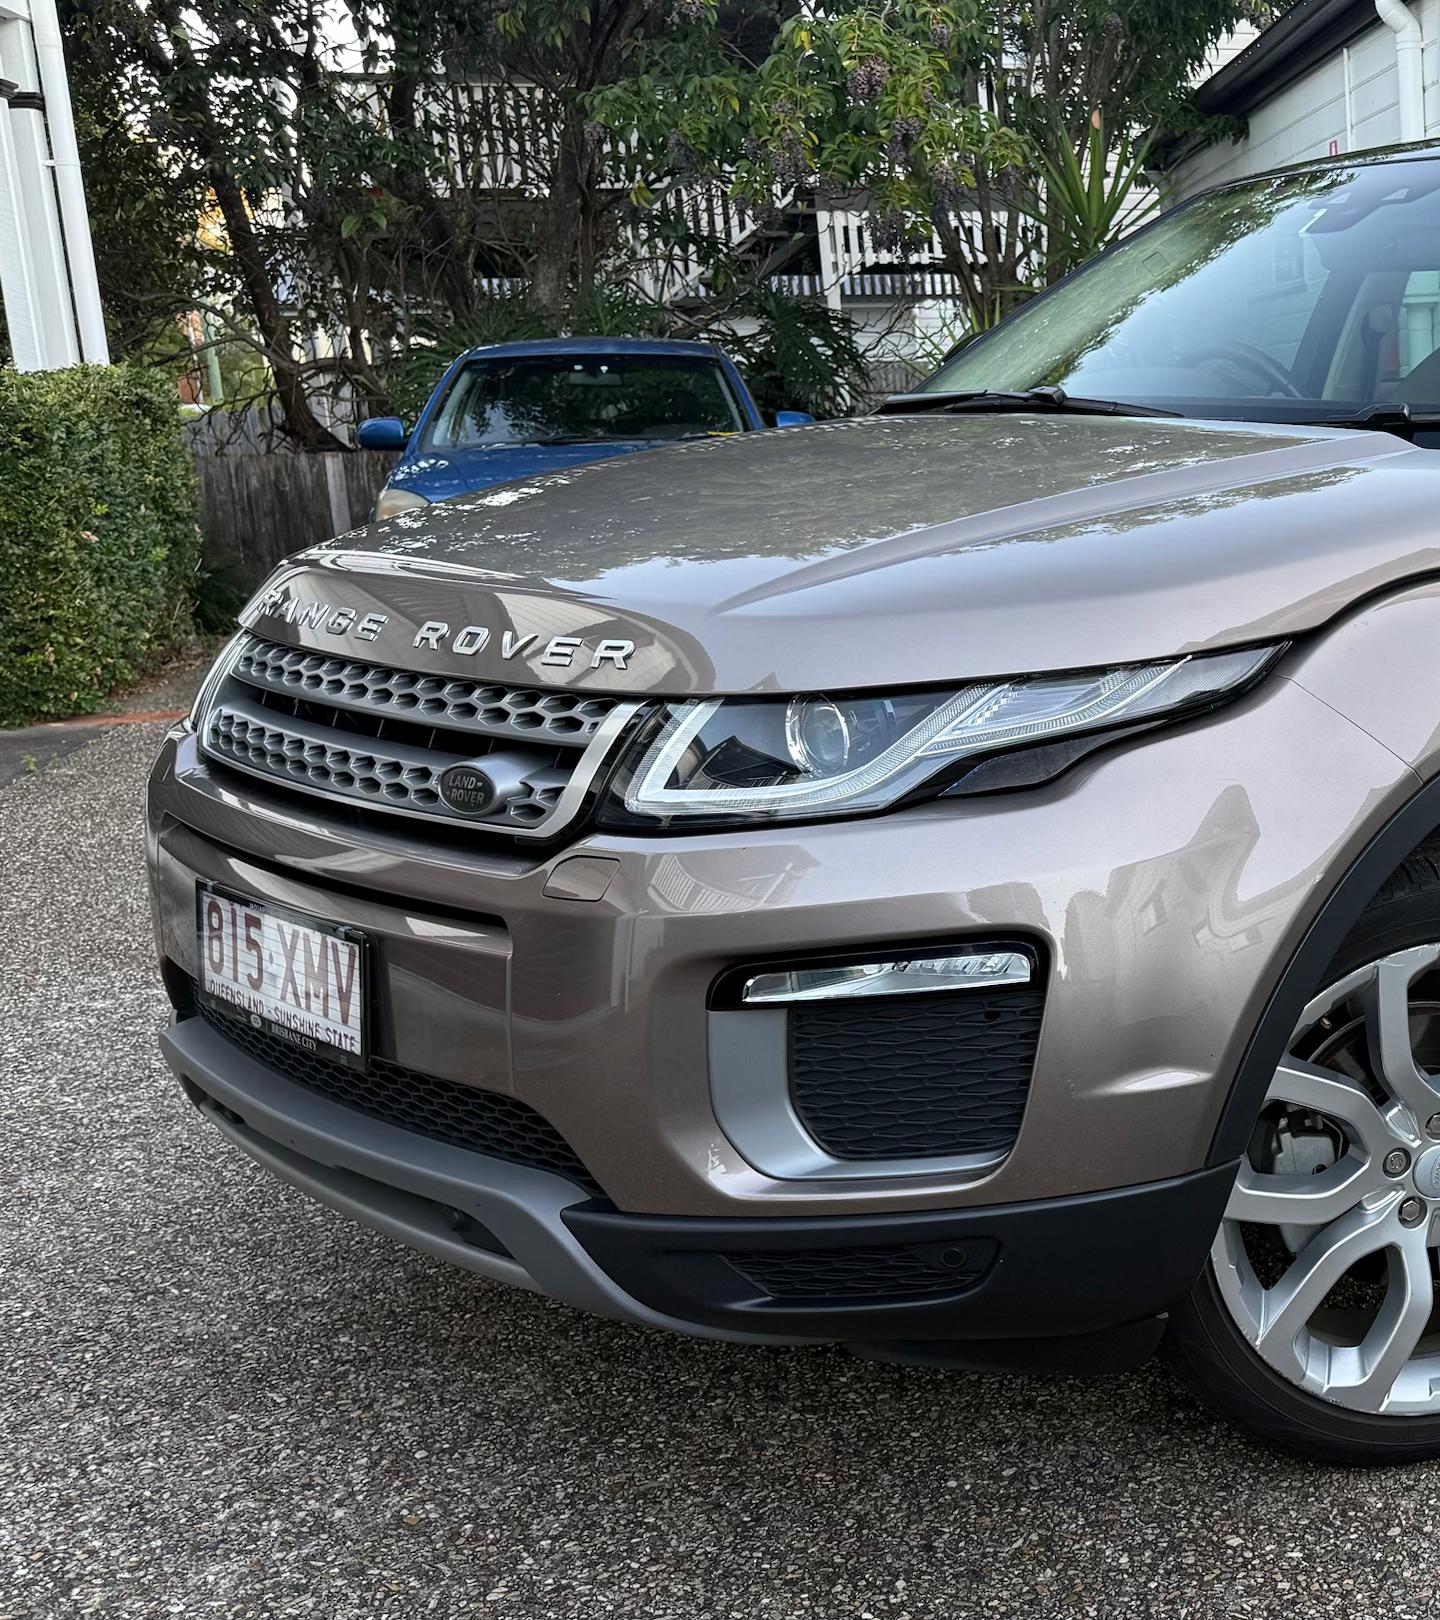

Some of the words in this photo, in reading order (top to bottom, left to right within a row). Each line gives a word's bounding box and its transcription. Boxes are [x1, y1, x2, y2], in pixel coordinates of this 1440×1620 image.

[258, 589, 389, 641] RANGE
[413, 621, 635, 670] ROVER
[448, 774, 477, 789] LAND
[451, 788, 485, 804] ROVER
[209, 979, 264, 1016] QUEENSLAND
[274, 1006, 320, 1040] SUNSHINE
[325, 1027, 356, 1052] STATE
[271, 1022, 301, 1045] BRISBANE
[301, 1036, 317, 1051] CITY
